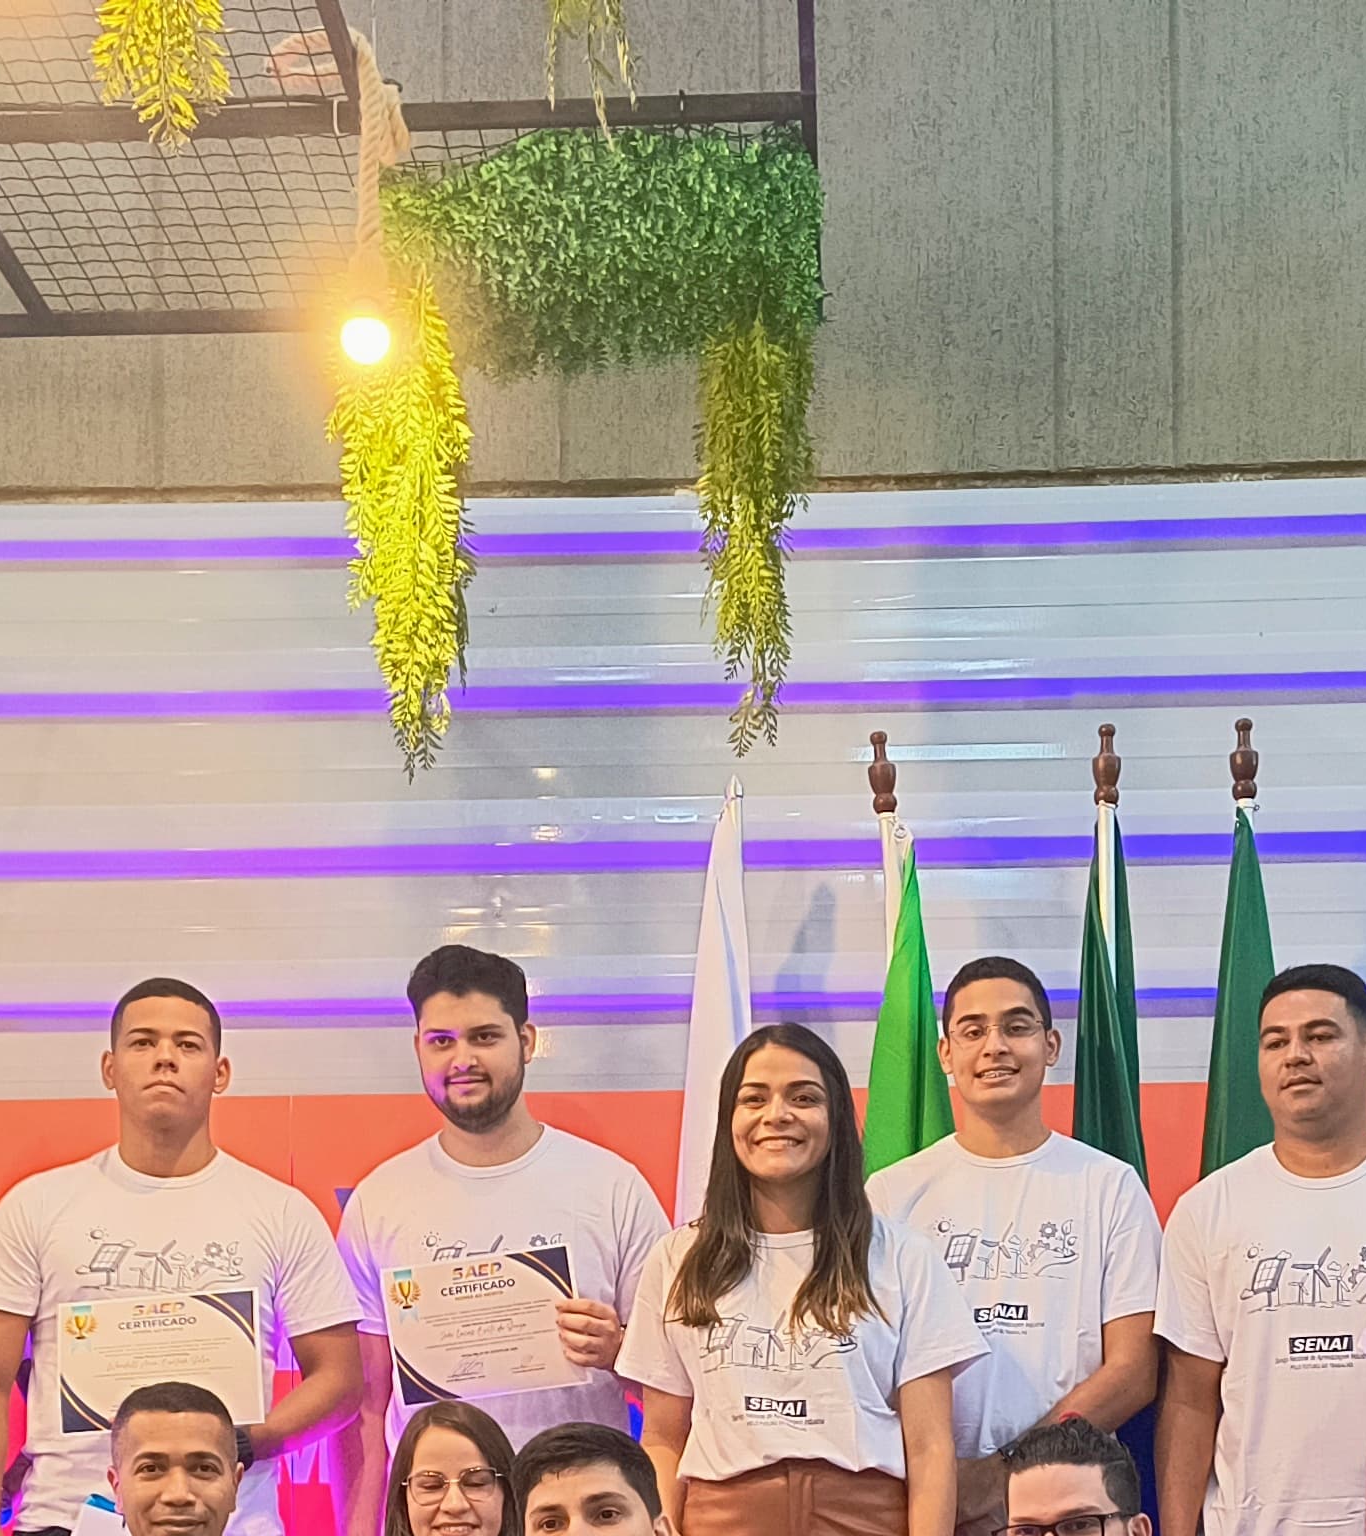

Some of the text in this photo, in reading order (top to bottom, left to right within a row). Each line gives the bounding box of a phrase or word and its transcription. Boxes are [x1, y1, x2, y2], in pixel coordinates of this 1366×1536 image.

[452, 1262, 502, 1281] SAEP
[441, 1278, 515, 1297] CERTIFICADO
[117, 1316, 197, 1330] CERTIFICADO
[1293, 1337, 1348, 1352] SENAI
[749, 1397, 803, 1416] SENAI
